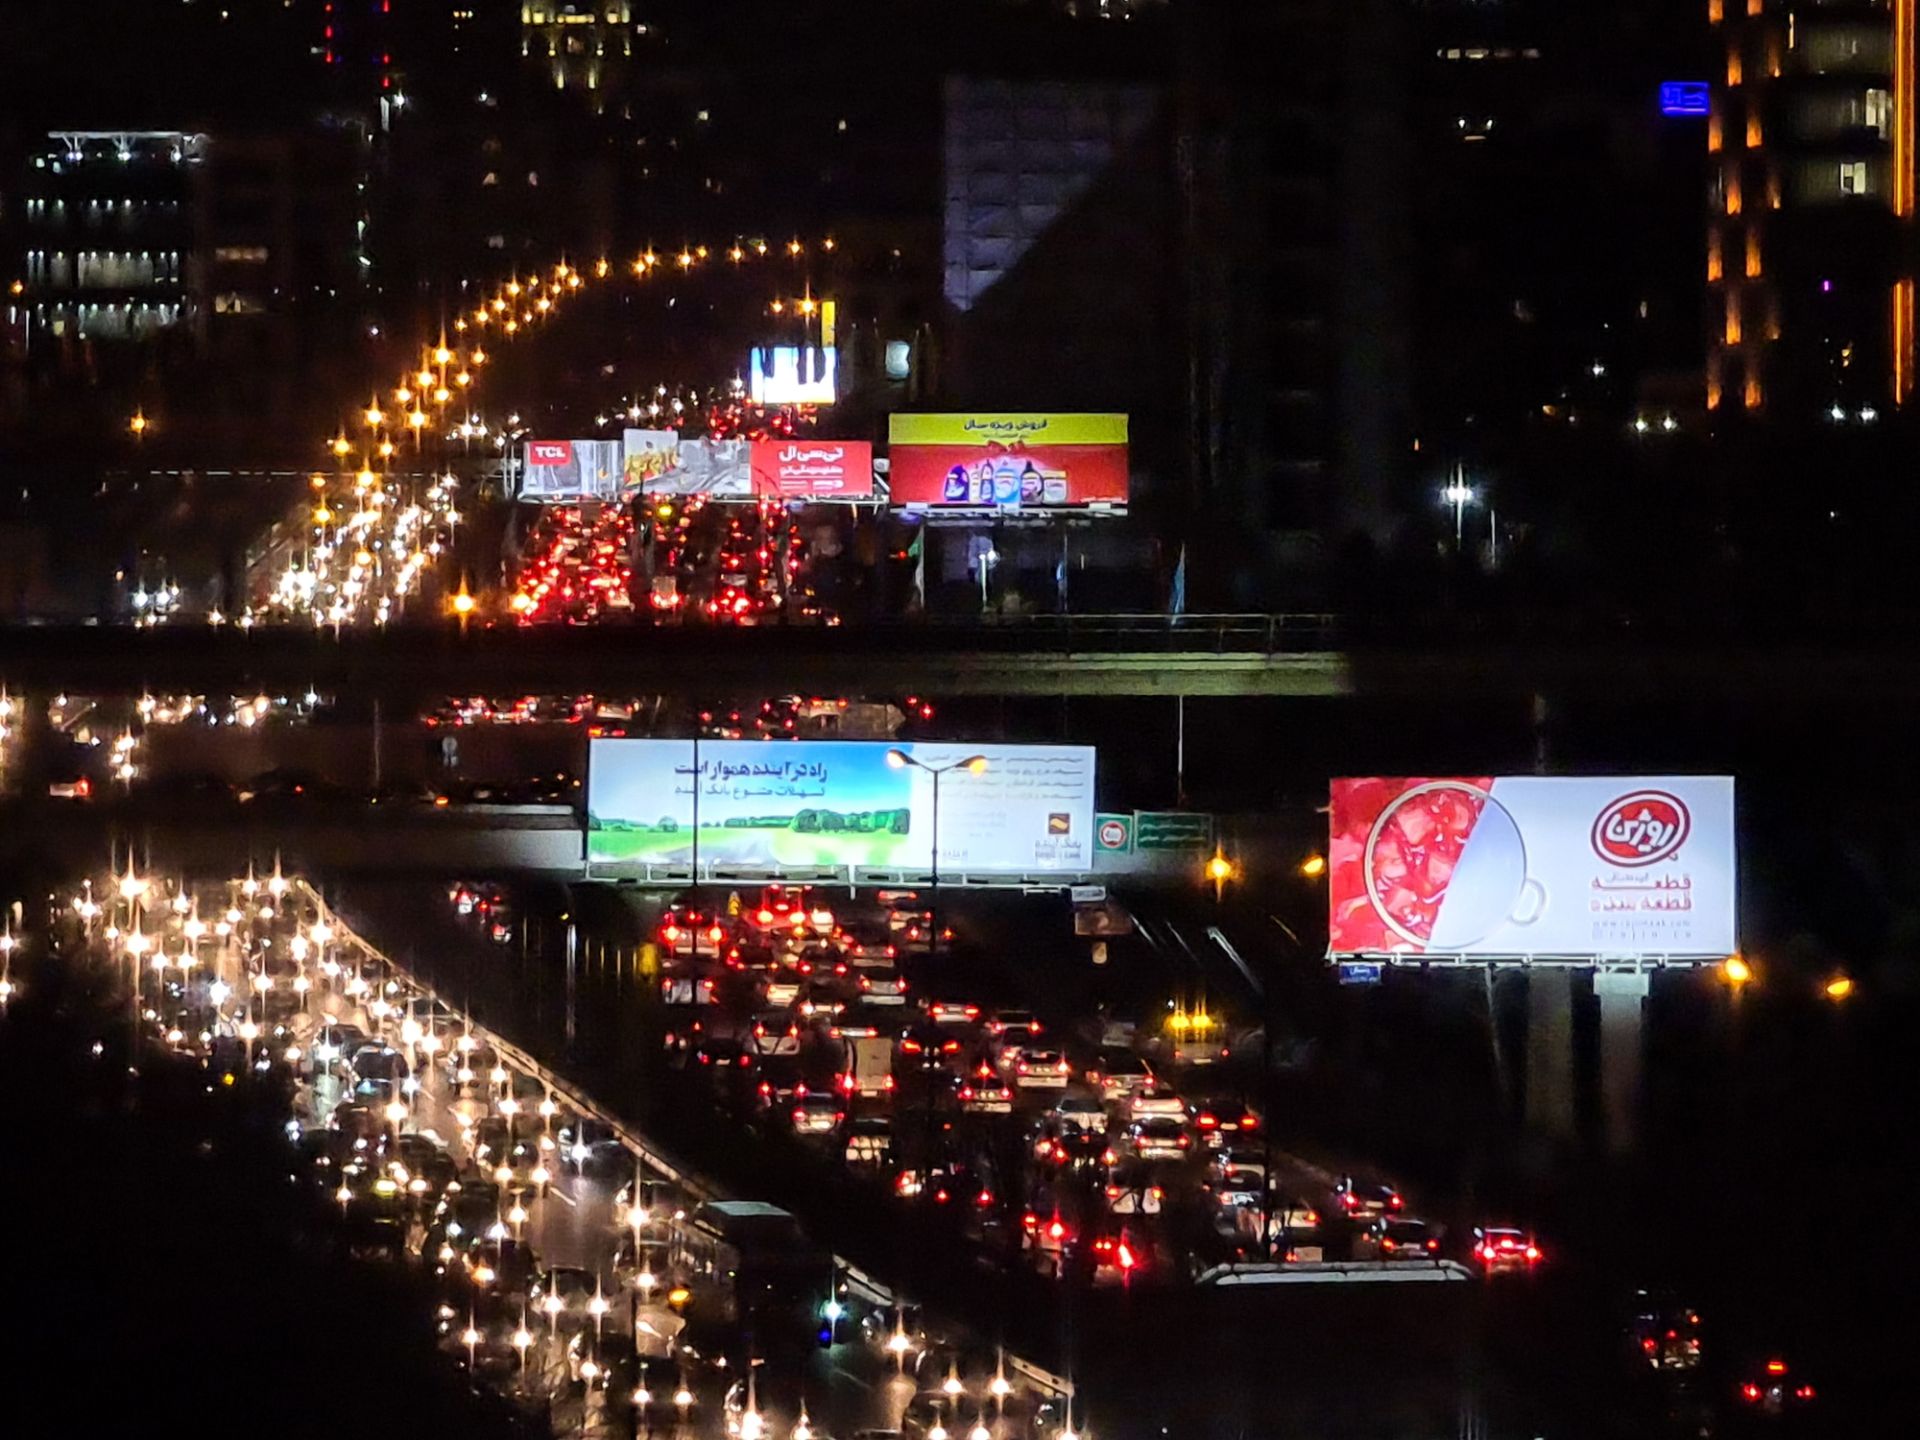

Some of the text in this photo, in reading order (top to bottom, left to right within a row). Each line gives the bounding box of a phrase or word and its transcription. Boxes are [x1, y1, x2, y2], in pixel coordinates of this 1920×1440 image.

[535, 446, 566, 458] TCL
[710, 760, 751, 780] هموار
[790, 762, 807, 782] در
[808, 762, 828, 783] راه
[1591, 872, 1692, 891] قطعه
